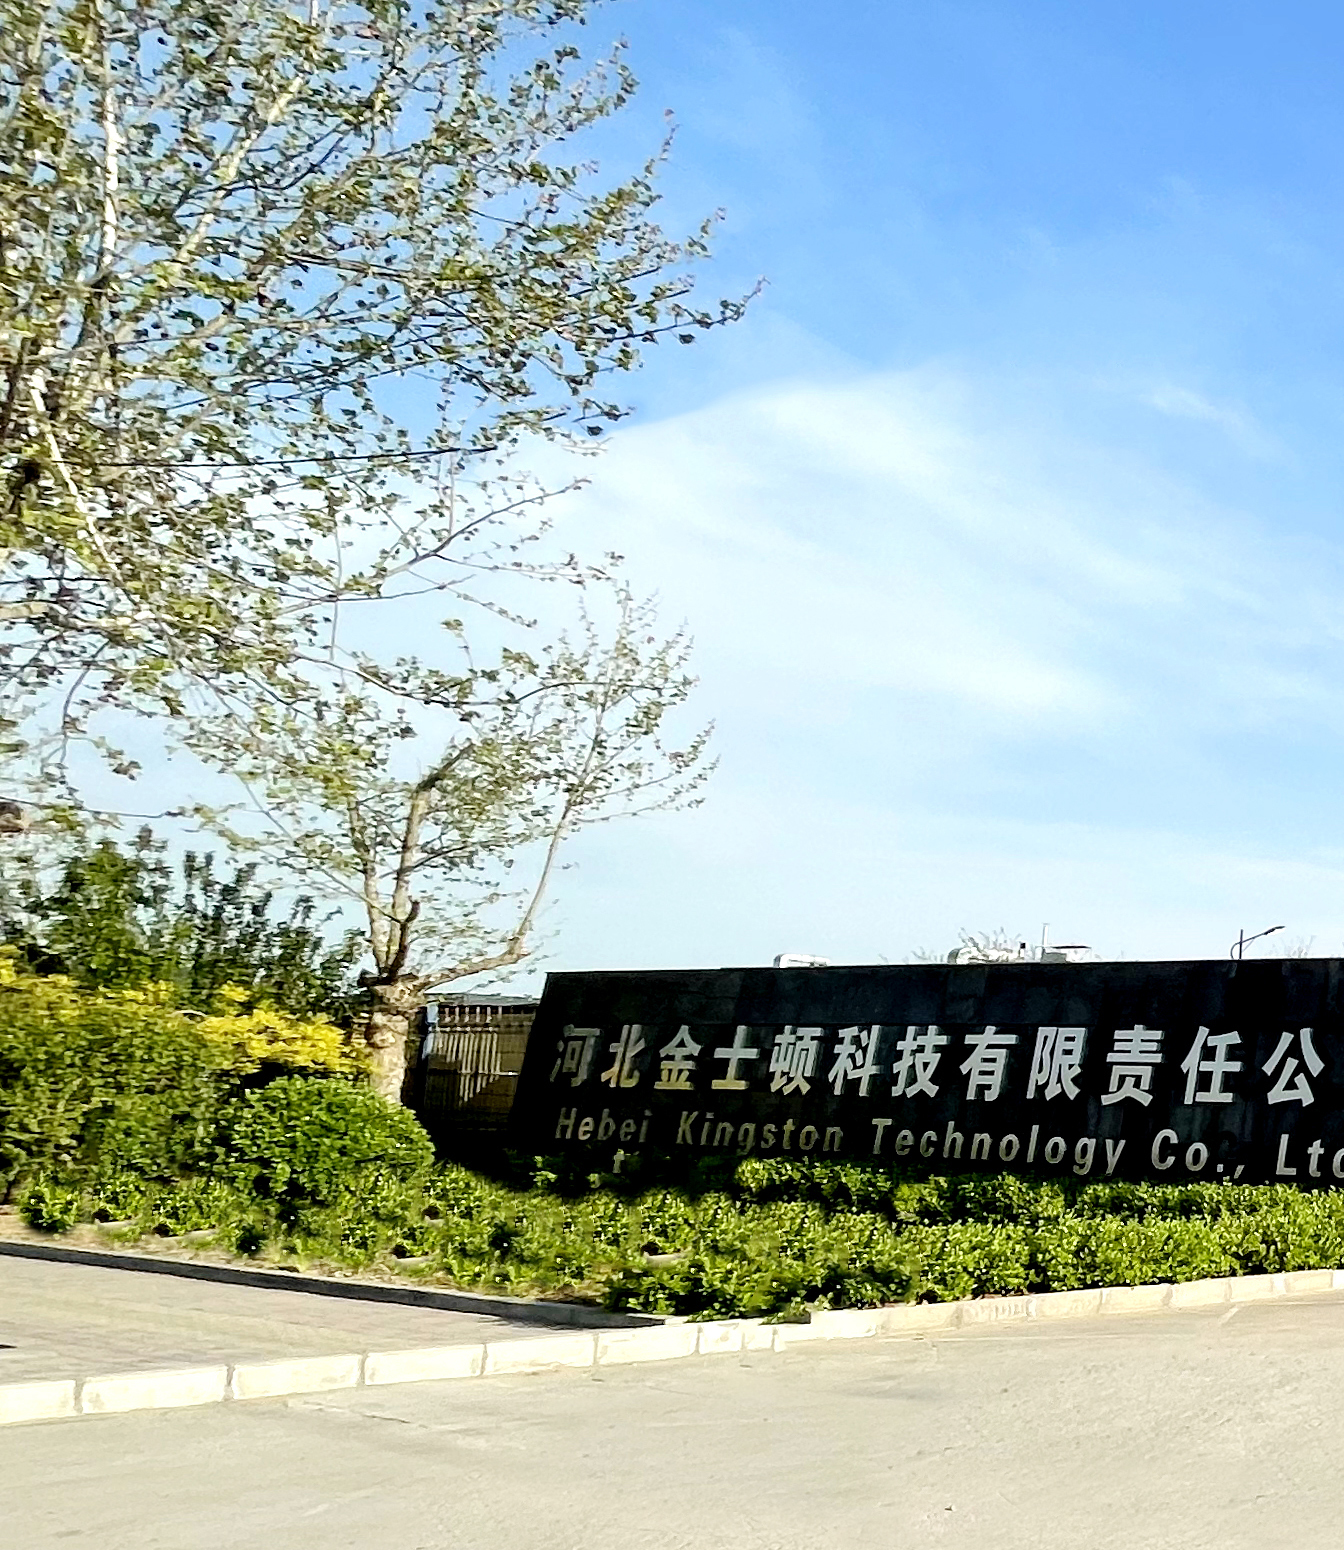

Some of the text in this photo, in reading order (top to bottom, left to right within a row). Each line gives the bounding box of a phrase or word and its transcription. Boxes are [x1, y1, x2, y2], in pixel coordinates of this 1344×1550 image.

[555, 1107, 652, 1143] Hebei
[676, 1111, 844, 1155] Kingston
[872, 1118, 1126, 1176] Technology
[1151, 1129, 1246, 1179] Co.,
